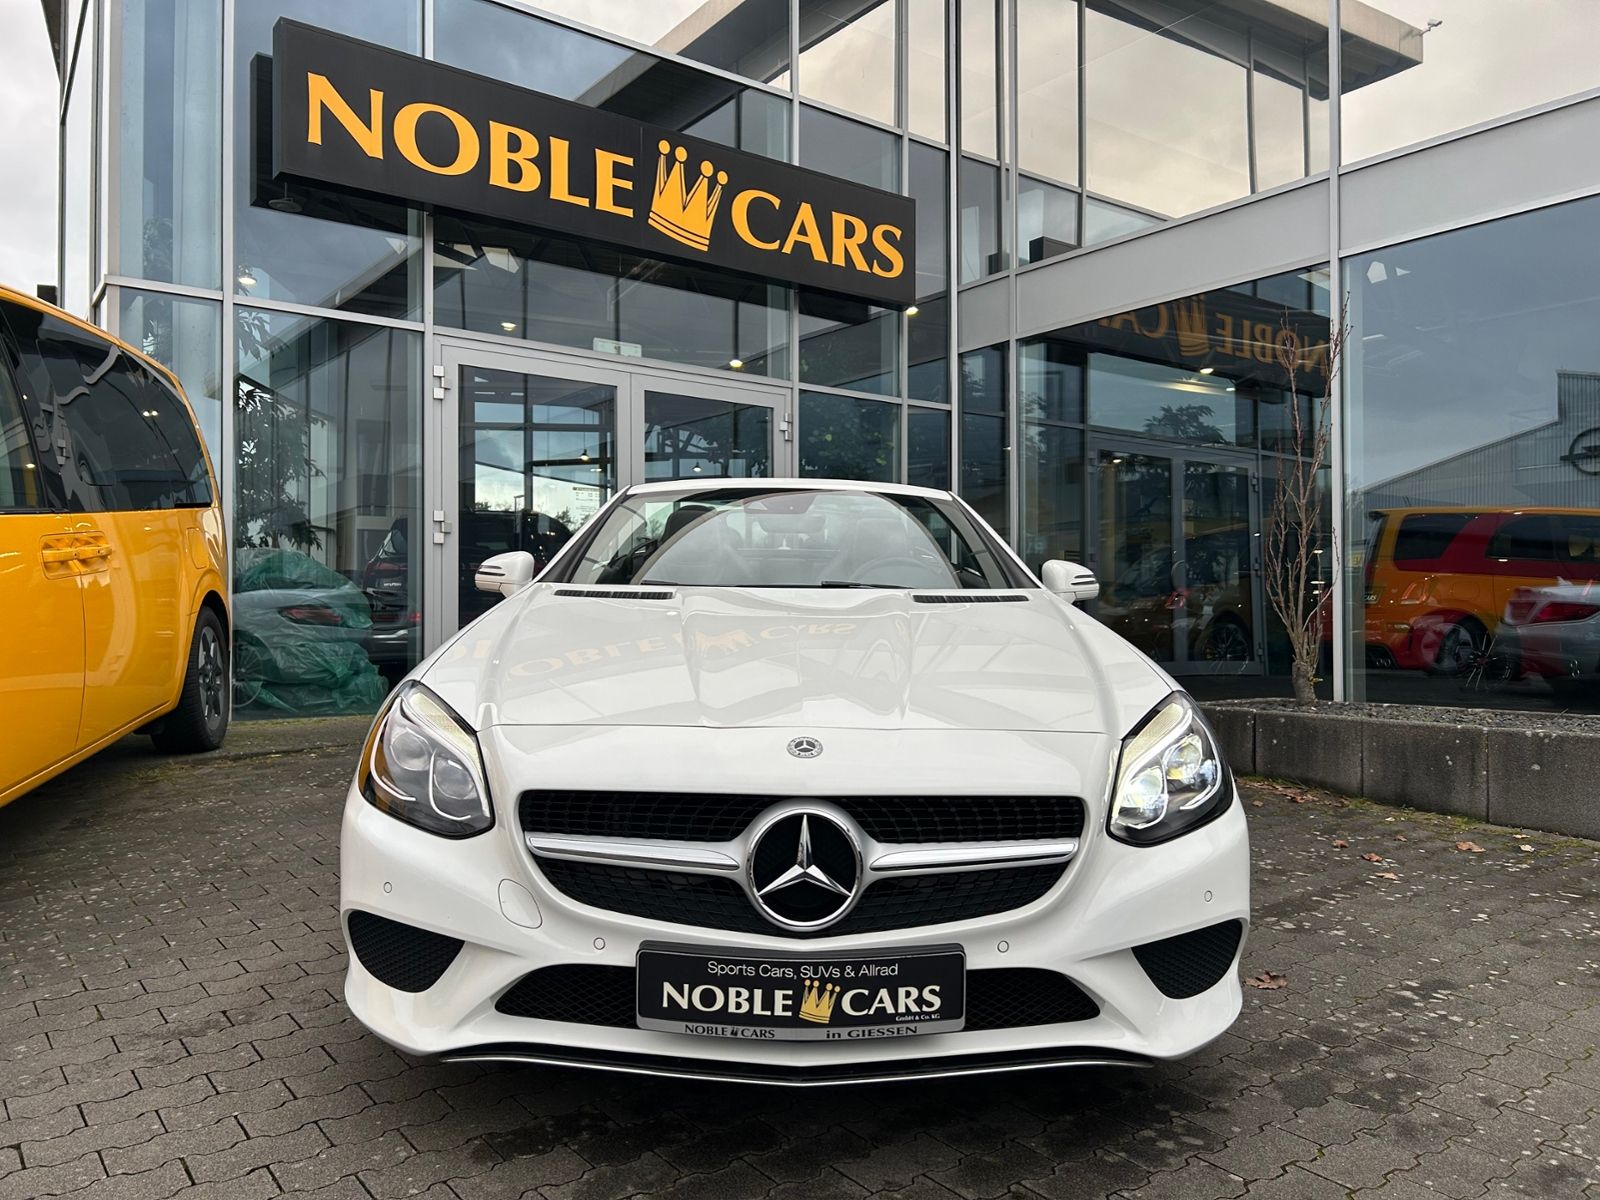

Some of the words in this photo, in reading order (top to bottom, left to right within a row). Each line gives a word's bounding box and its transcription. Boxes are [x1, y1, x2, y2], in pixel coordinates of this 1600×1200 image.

[307, 73, 635, 218] NOBLE
[731, 188, 904, 278] CARS
[707, 961, 756, 976] Sports
[758, 964, 797, 980] Cars,
[800, 965, 841, 978] SUVs
[844, 966, 855, 978] &
[858, 963, 899, 977] Allrad
[662, 981, 793, 1017] NOBLE
[841, 984, 942, 1014] CARS
[684, 1023, 728, 1036] NOBLE
[741, 1027, 775, 1039] CARS
[826, 1030, 841, 1039] in
[847, 1025, 918, 1038] GIESSEN
